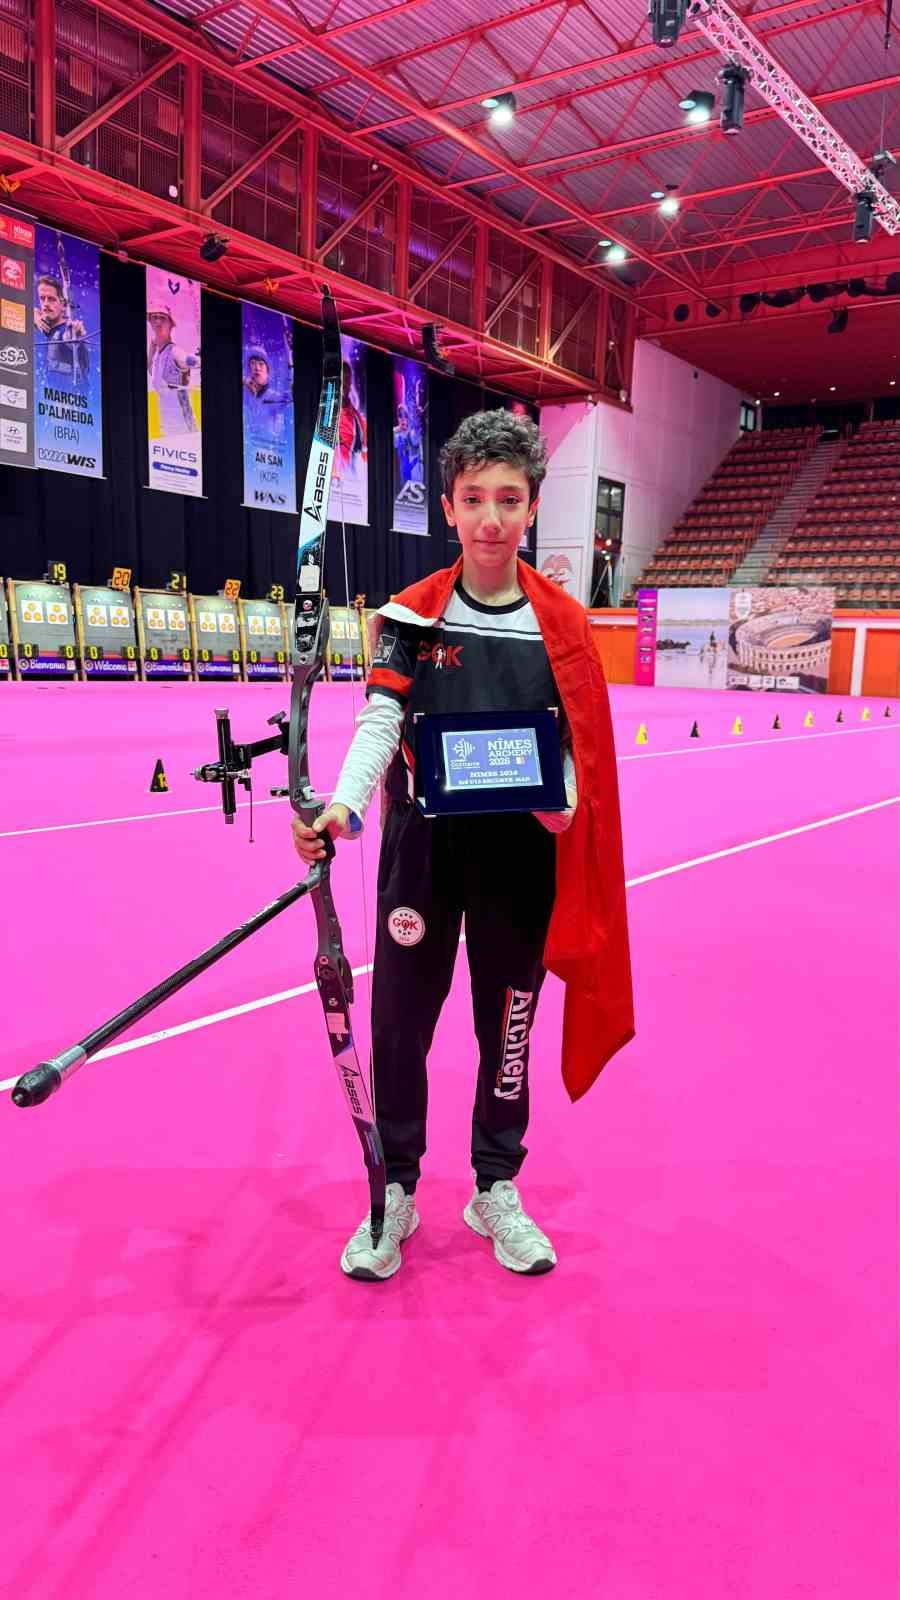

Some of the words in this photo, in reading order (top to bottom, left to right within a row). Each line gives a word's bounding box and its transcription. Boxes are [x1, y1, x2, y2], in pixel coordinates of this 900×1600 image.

[44, 387, 88, 409] MARCUS
[38, 402, 94, 426] D'ALMEIDA
[54, 425, 80, 445] (BRA)
[153, 445, 197, 463] FIVICS
[255, 451, 266, 465] AN
[267, 453, 284, 467] SAN
[53, 563, 67, 580] 19
[114, 570, 130, 585] 20
[170, 573, 186, 590] 21
[225, 581, 240, 596] 22
[271, 585, 284, 600] 23
[94, 660, 128, 671] Welcome
[487, 737, 532, 751] NÎMES
[488, 749, 533, 758] ARCHERY
[494, 990, 533, 1100] Archery
